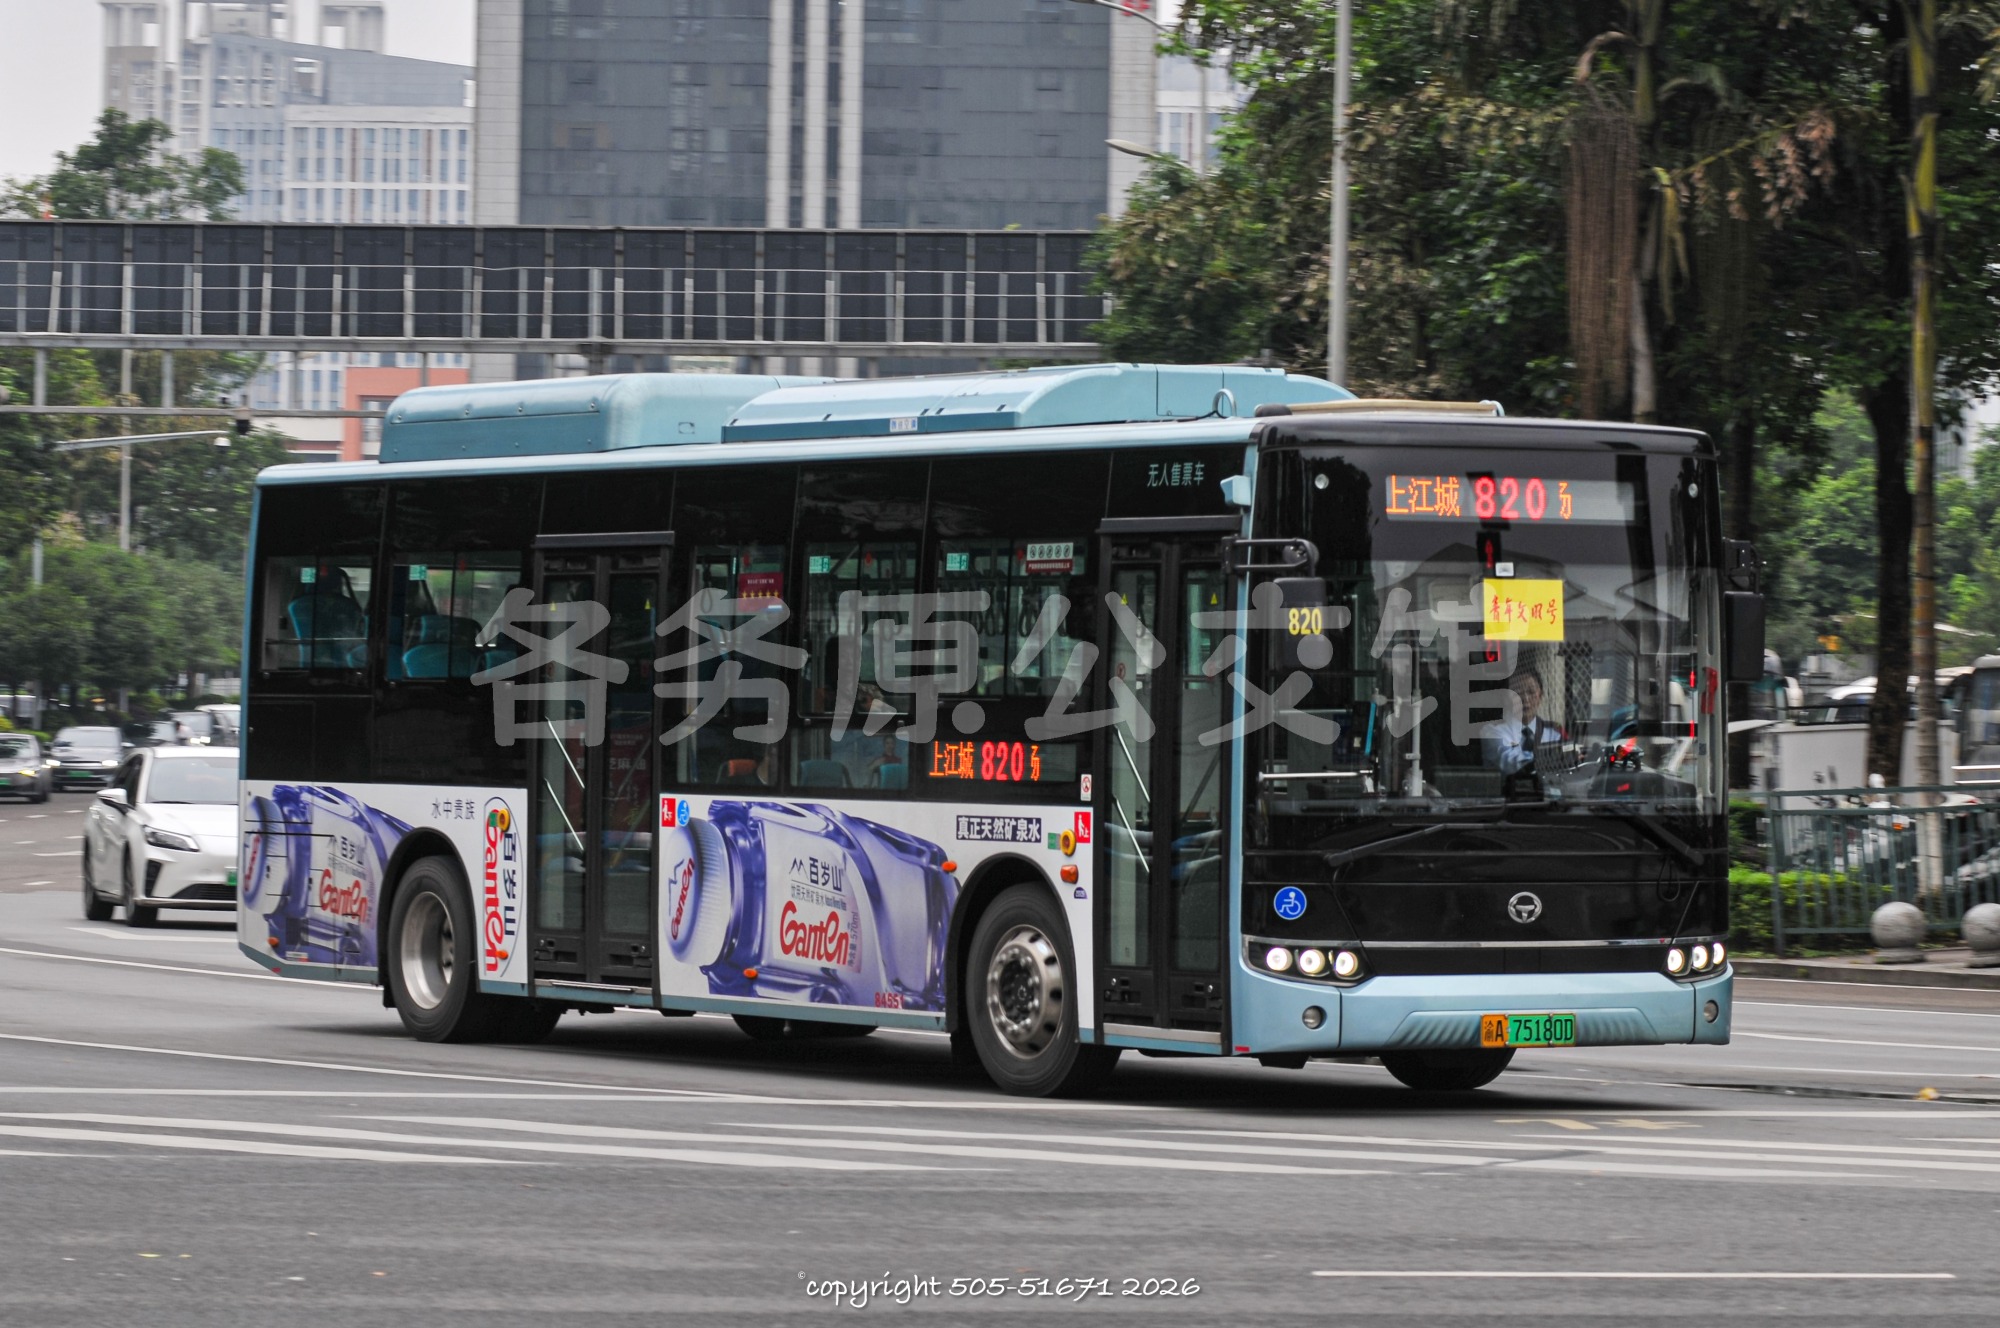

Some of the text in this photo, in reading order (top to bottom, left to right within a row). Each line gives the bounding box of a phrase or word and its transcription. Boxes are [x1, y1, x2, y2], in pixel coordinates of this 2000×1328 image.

[1147, 461, 1205, 487] 无人售票车
[1386, 475, 1460, 517] 上江城
[1475, 476, 1547, 520] 820
[1288, 607, 1322, 636] 820
[1490, 594, 1558, 625] 青年文明号
[929, 740, 975, 779] 上江城
[981, 741, 1025, 782] 820
[431, 797, 475, 820] 水中贵族
[958, 816, 1041, 842] 真正天然矿泉水
[503, 832, 517, 936] 百岁山
[808, 856, 843, 892] 百岁山
[780, 900, 850, 966] Ganten
[1513, 1018, 1574, 1043] 75180D
